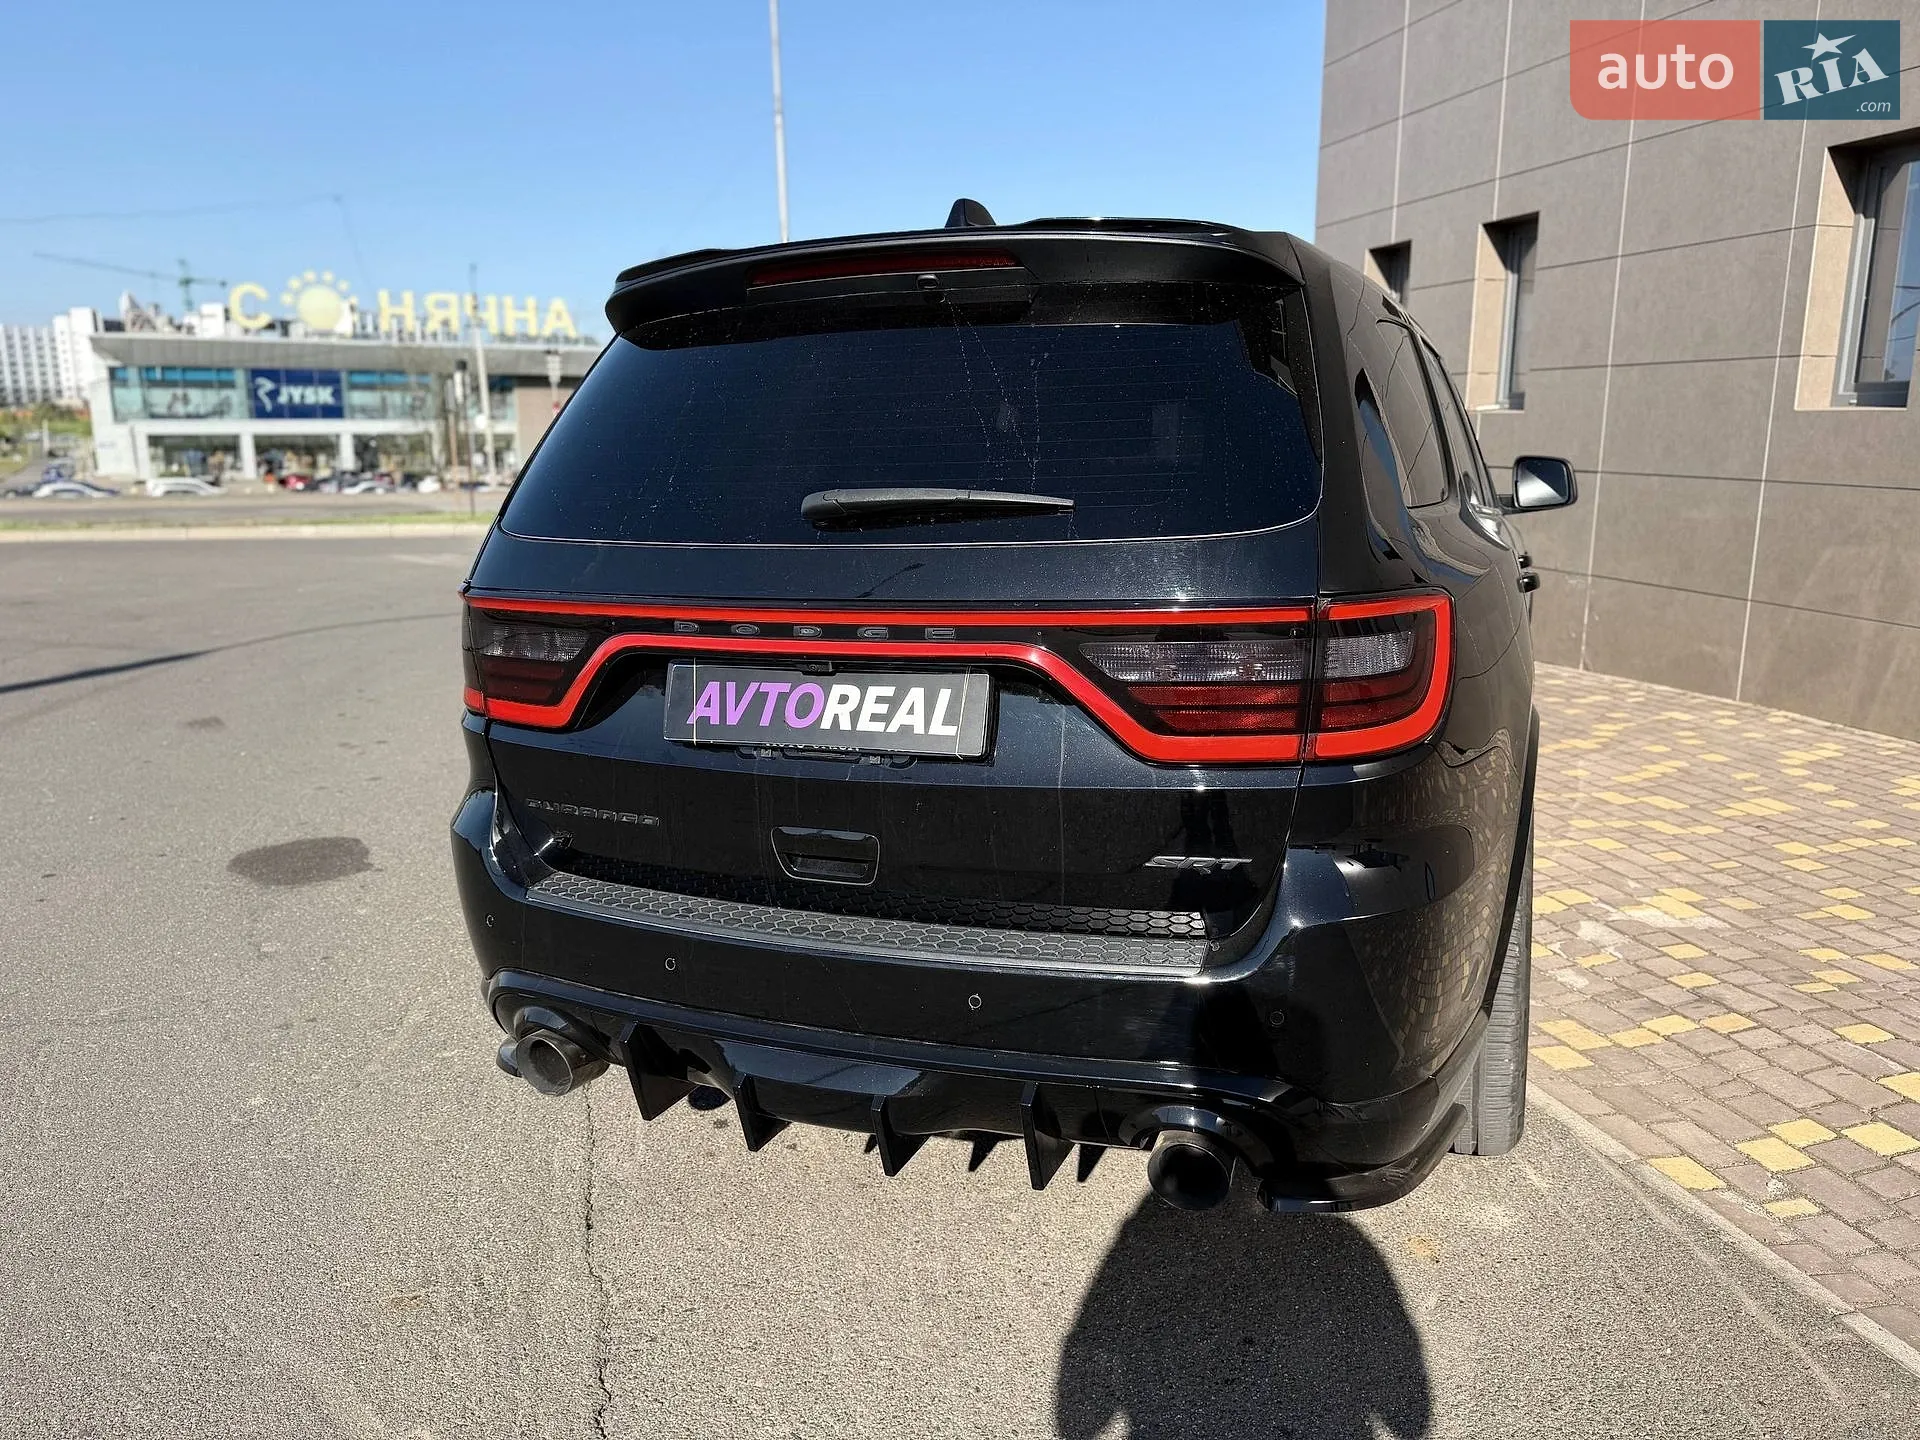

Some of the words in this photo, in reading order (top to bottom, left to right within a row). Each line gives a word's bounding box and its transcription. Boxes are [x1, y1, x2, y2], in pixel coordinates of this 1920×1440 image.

[277, 385, 336, 405] JYSK
[674, 620, 956, 640] DODGE
[687, 681, 959, 737] AVTOREAL
[1143, 856, 1253, 874] SRT
